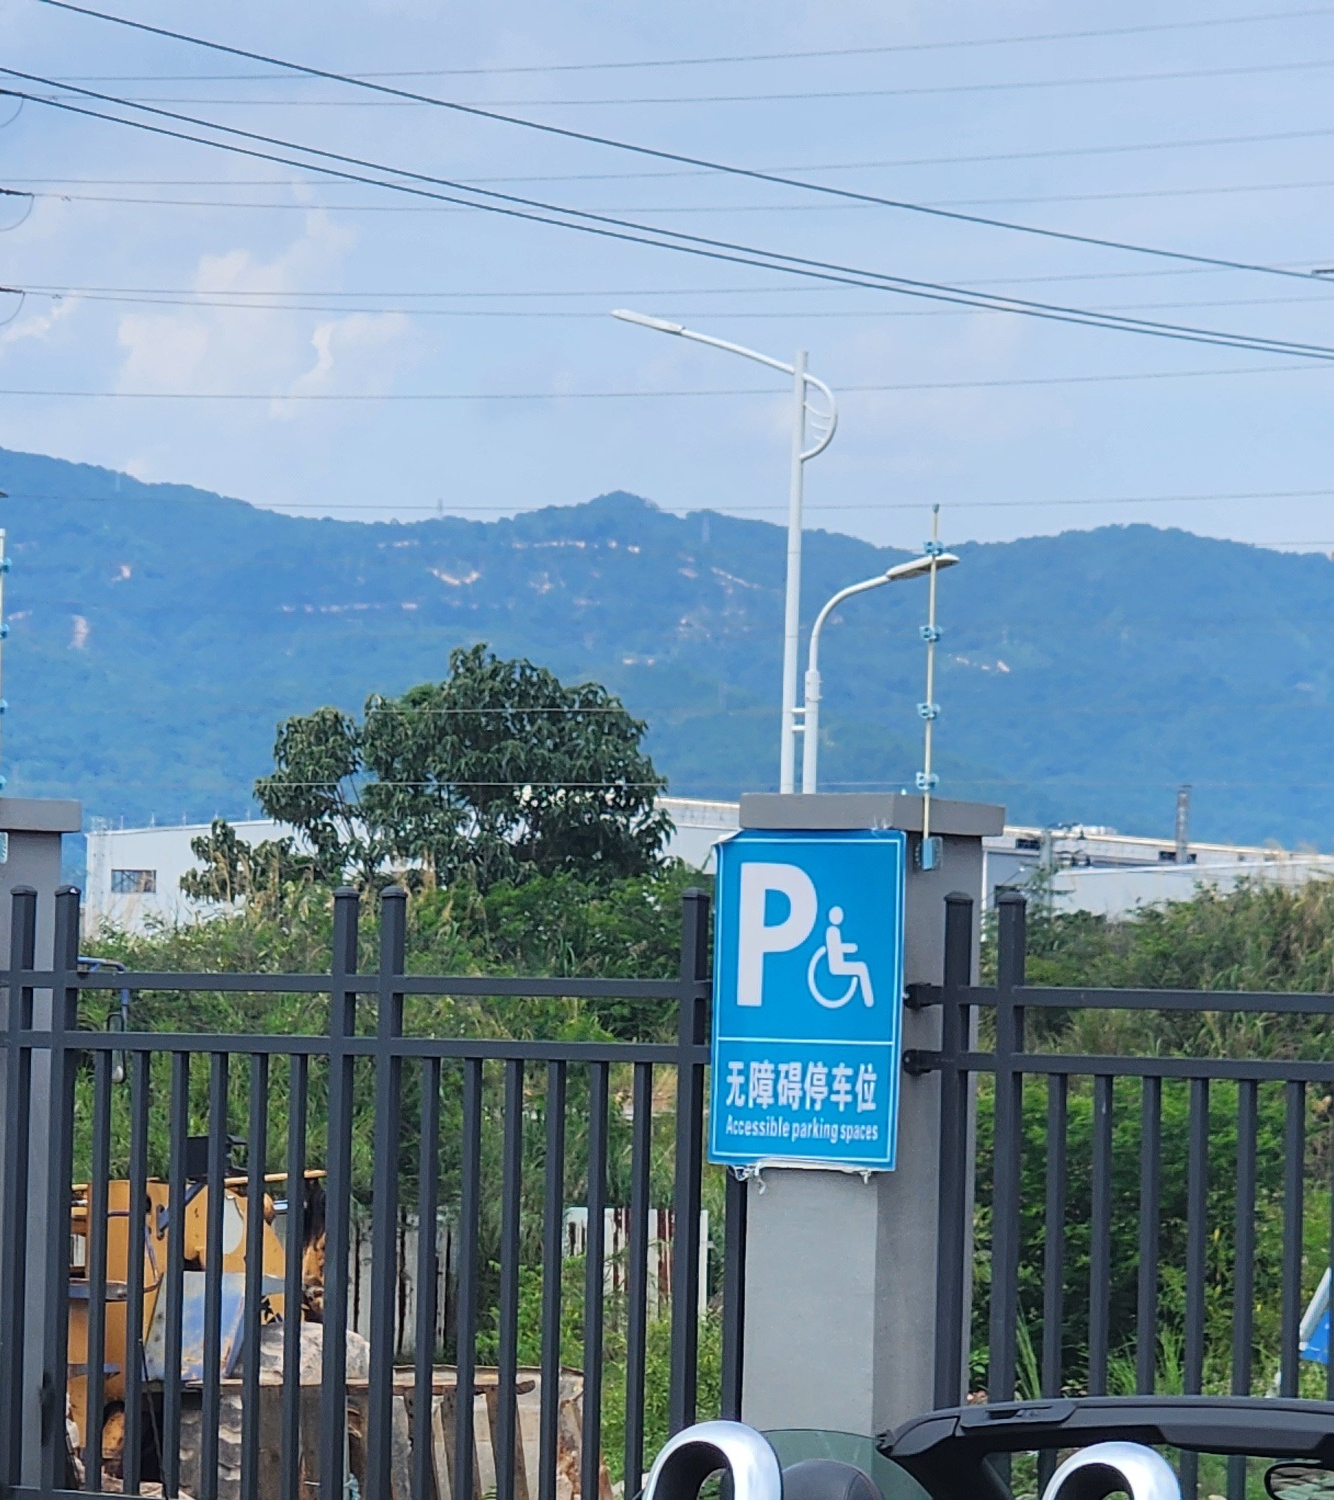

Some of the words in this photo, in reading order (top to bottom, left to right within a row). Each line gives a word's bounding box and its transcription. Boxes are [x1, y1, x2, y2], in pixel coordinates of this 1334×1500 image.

[736, 862, 818, 1007] P
[725, 1059, 878, 1113] 无障碍停车位
[725, 1114, 790, 1138] Accessible
[791, 1116, 839, 1144] parking
[840, 1123, 879, 1144] spaces
